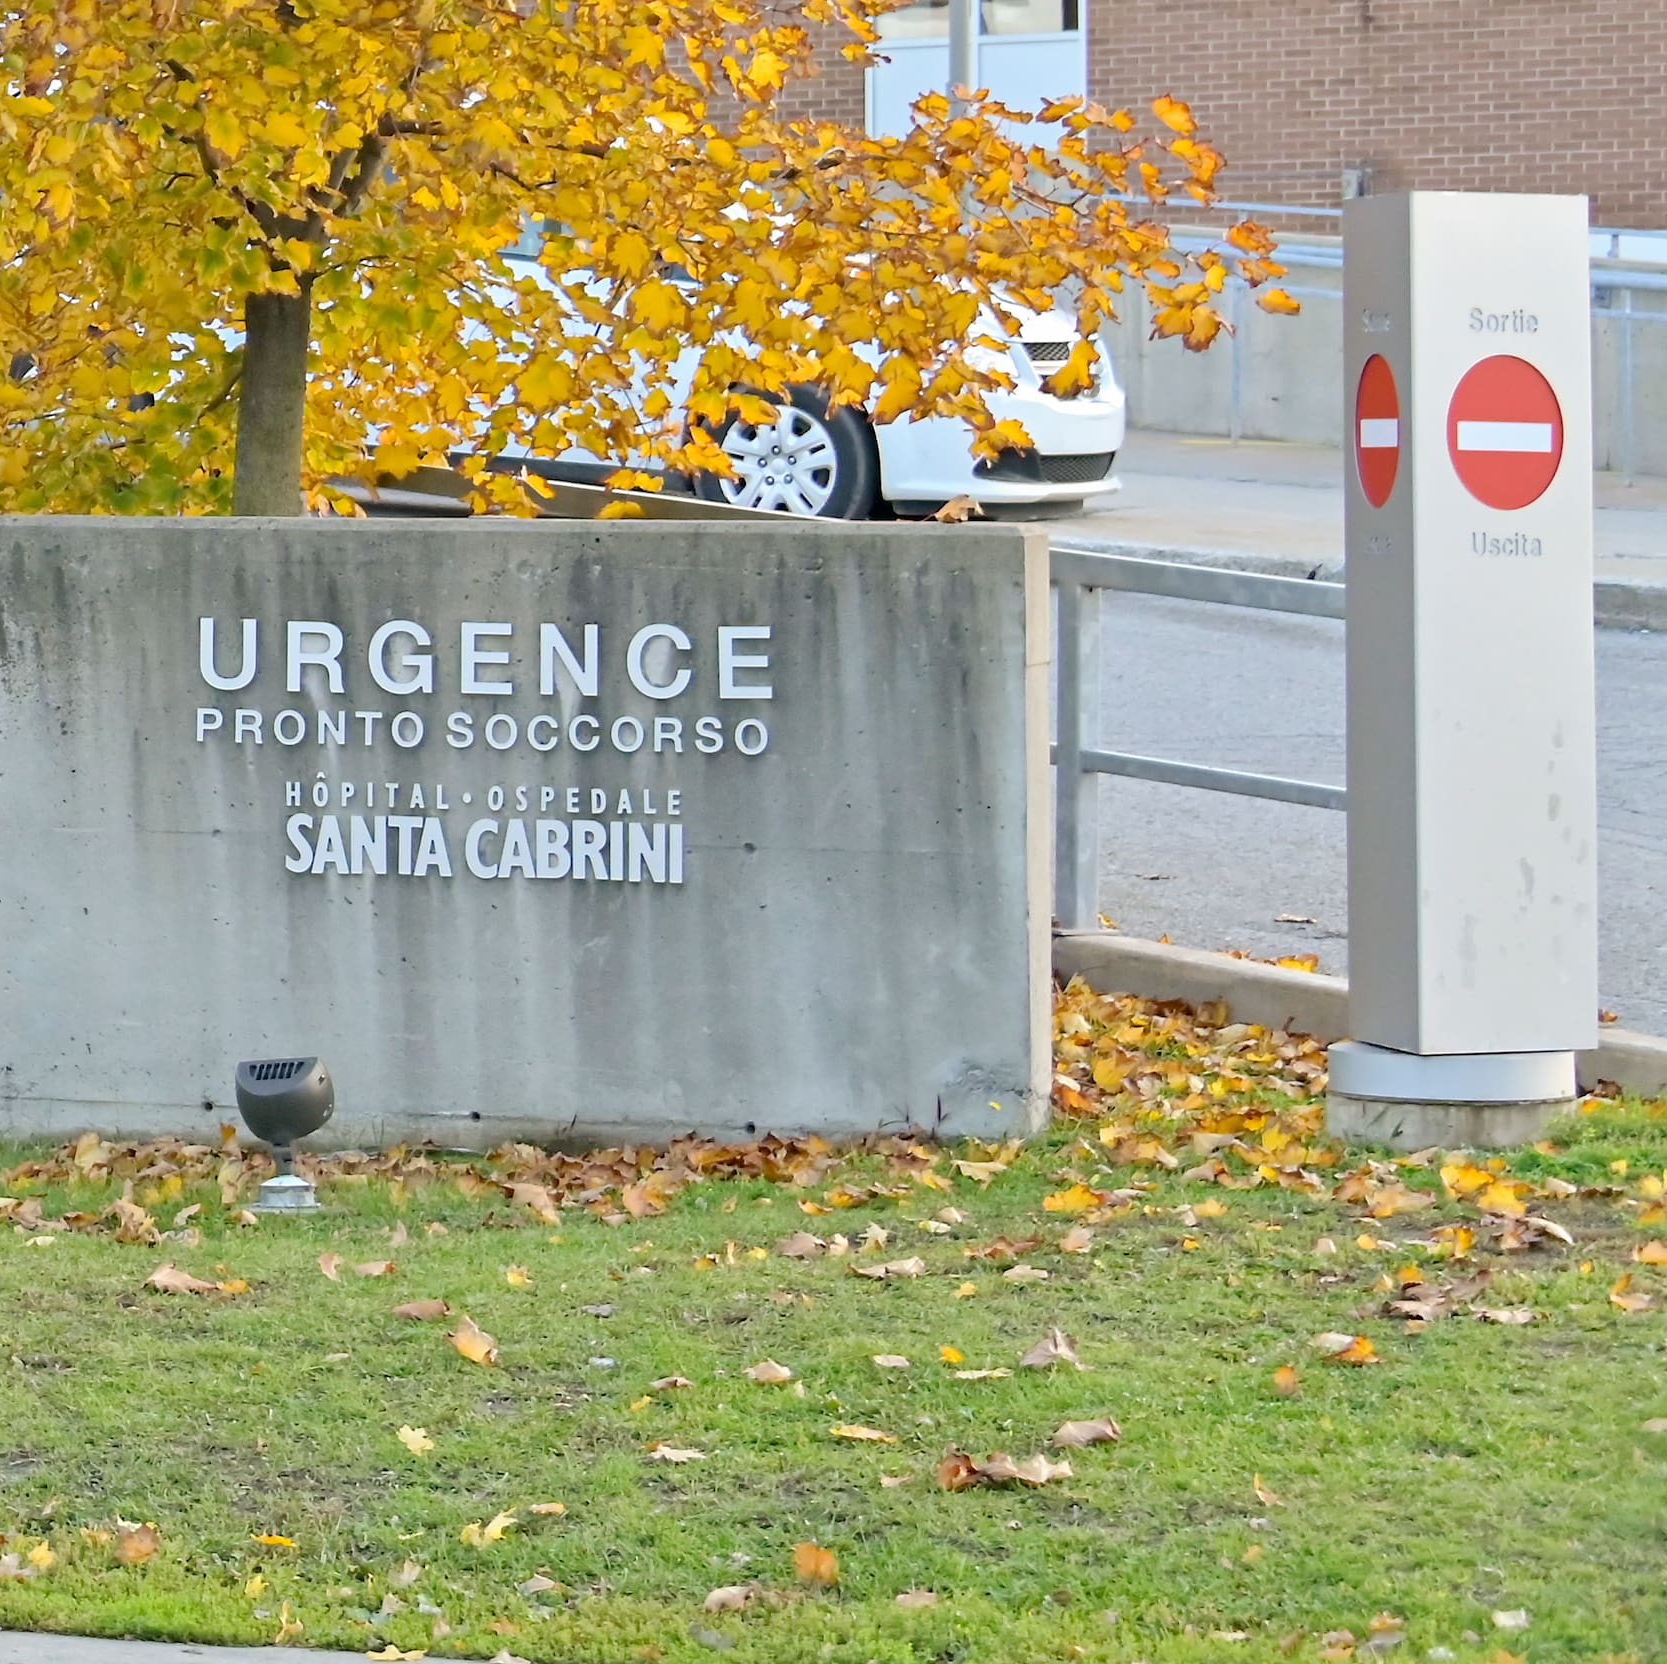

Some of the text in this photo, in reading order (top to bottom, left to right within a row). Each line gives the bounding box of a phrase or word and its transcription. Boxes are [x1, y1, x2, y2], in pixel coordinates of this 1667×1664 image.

[1468, 307, 1539, 334] Sortie
[1471, 532, 1543, 558] Uscita
[198, 616, 773, 700] URGENCE
[195, 707, 769, 756] PRONTO SOCCORSO
[285, 770, 682, 816] HÔPITAL OSPEDALE
[284, 812, 684, 885] SANTA CABRINI
